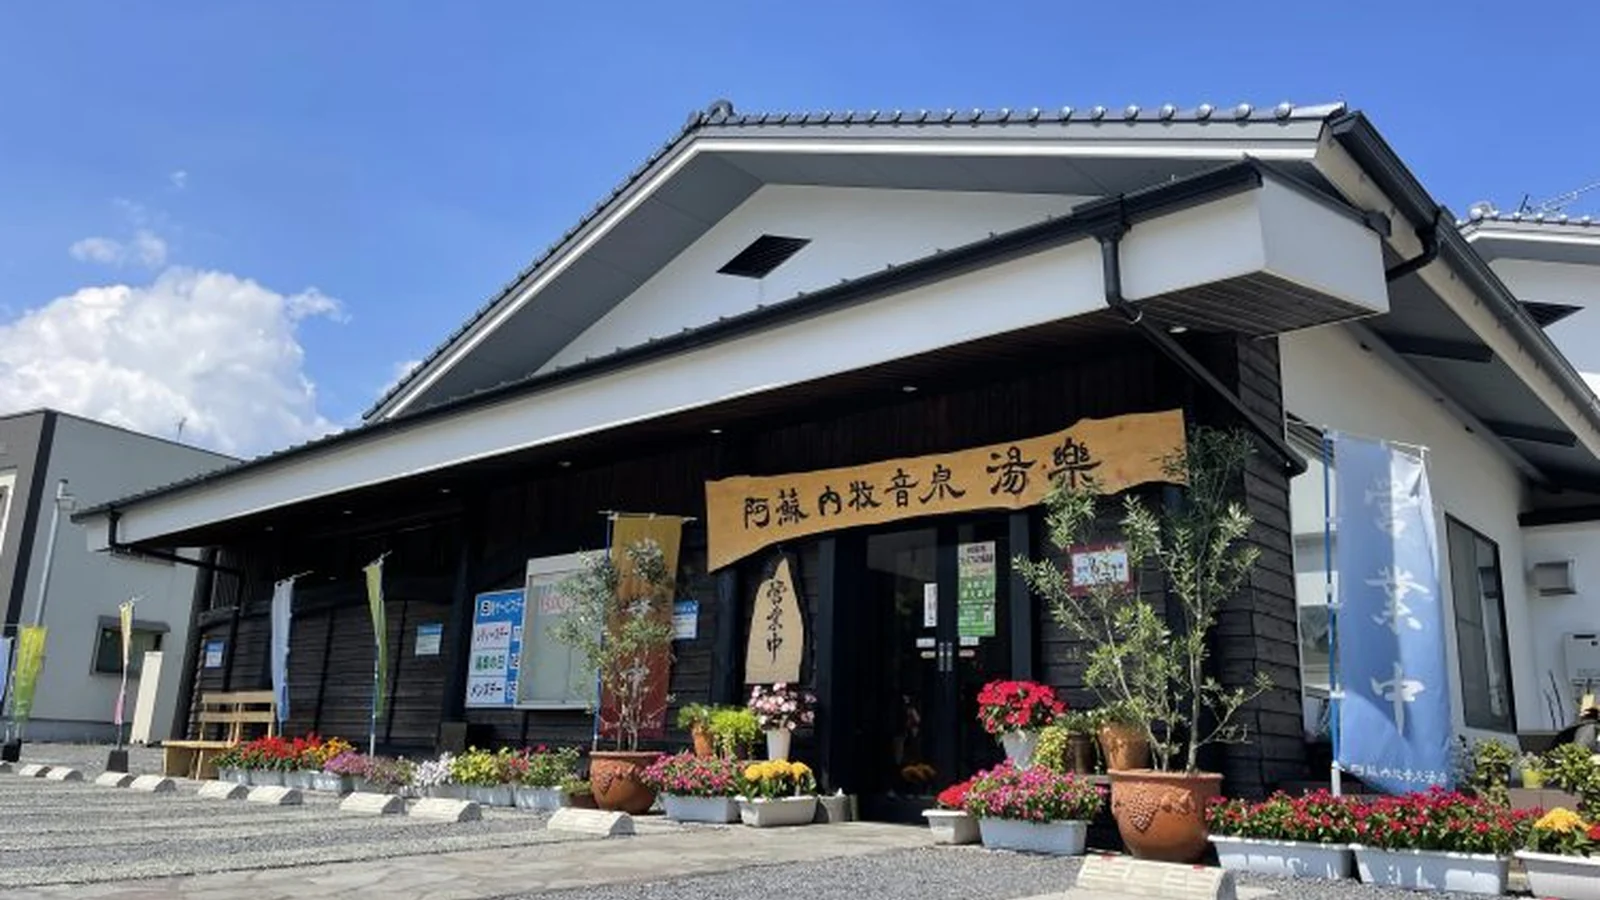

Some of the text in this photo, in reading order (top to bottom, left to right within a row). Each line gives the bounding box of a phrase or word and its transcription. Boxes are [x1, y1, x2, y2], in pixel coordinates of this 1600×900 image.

[743, 463, 967, 530] 阿蘇内牧音泉
[1363, 475, 1431, 736] 営業中
